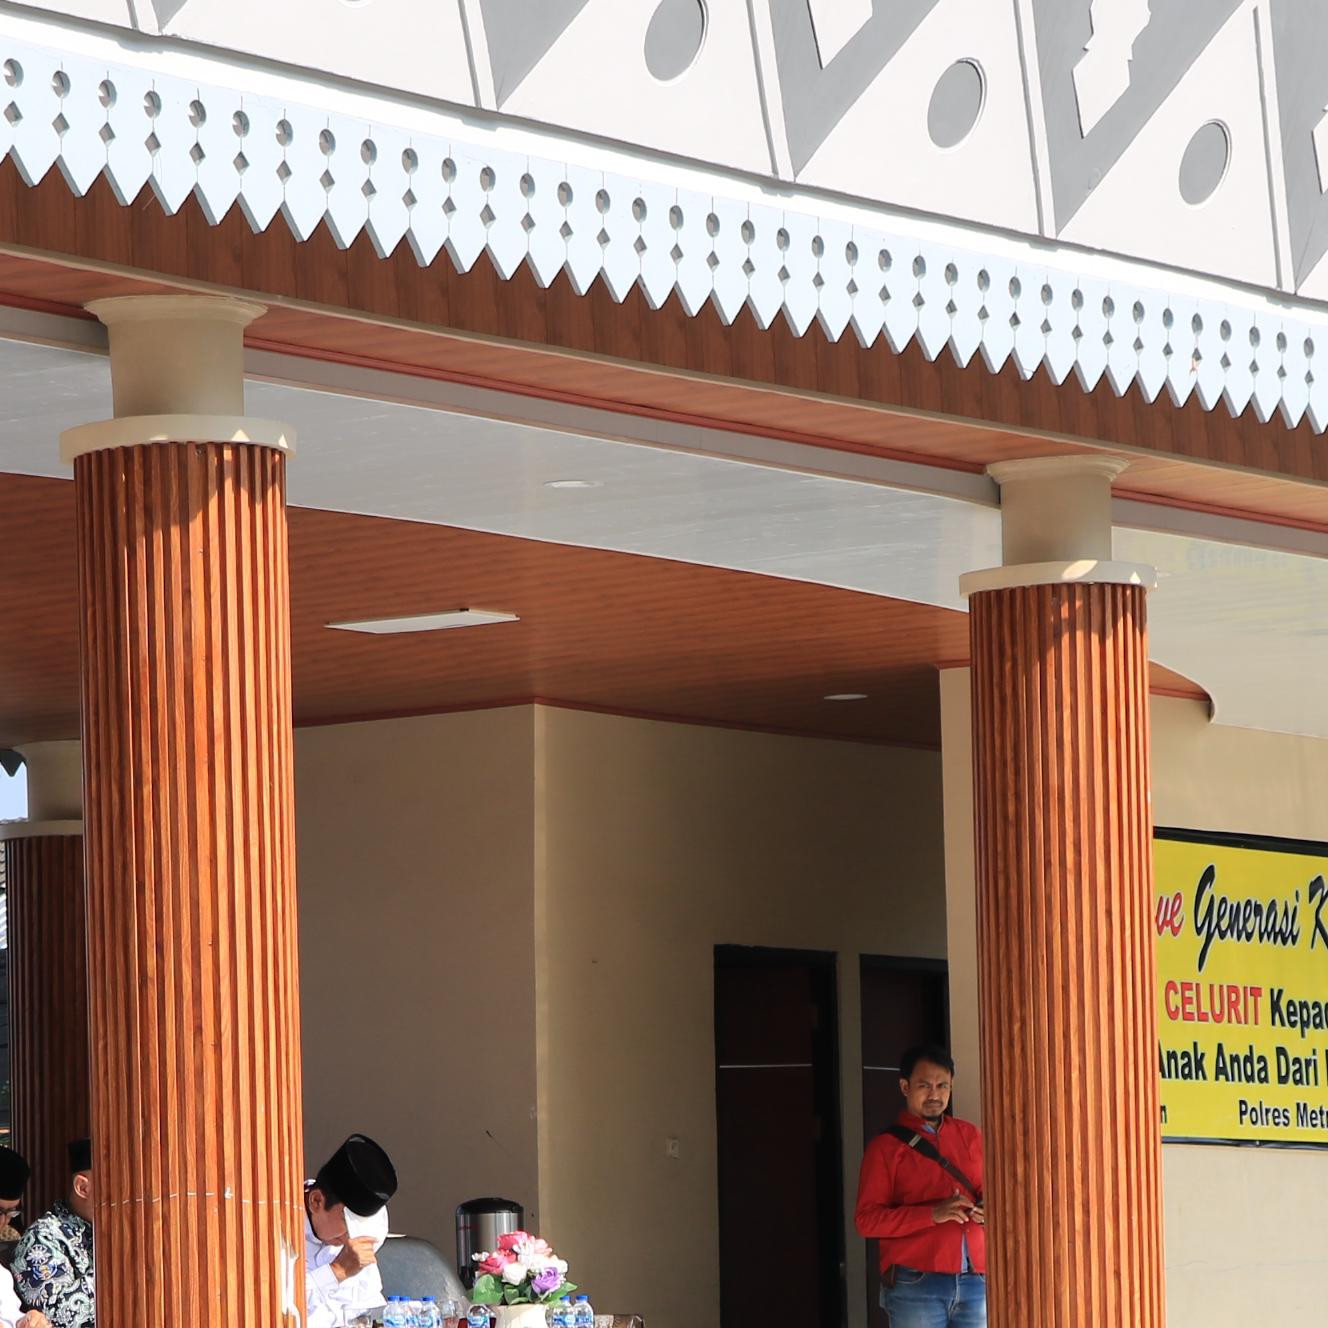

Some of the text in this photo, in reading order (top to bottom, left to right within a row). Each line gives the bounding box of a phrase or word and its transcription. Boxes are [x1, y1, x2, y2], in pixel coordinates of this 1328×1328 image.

[1155, 892, 1184, 936] ve
[1194, 864, 1300, 972] Generasi
[1164, 980, 1263, 1025] CELURIT
[1215, 1043, 1269, 1084] Anda
[1275, 1046, 1319, 1086] Dari
[1239, 1100, 1290, 1127] Polres
